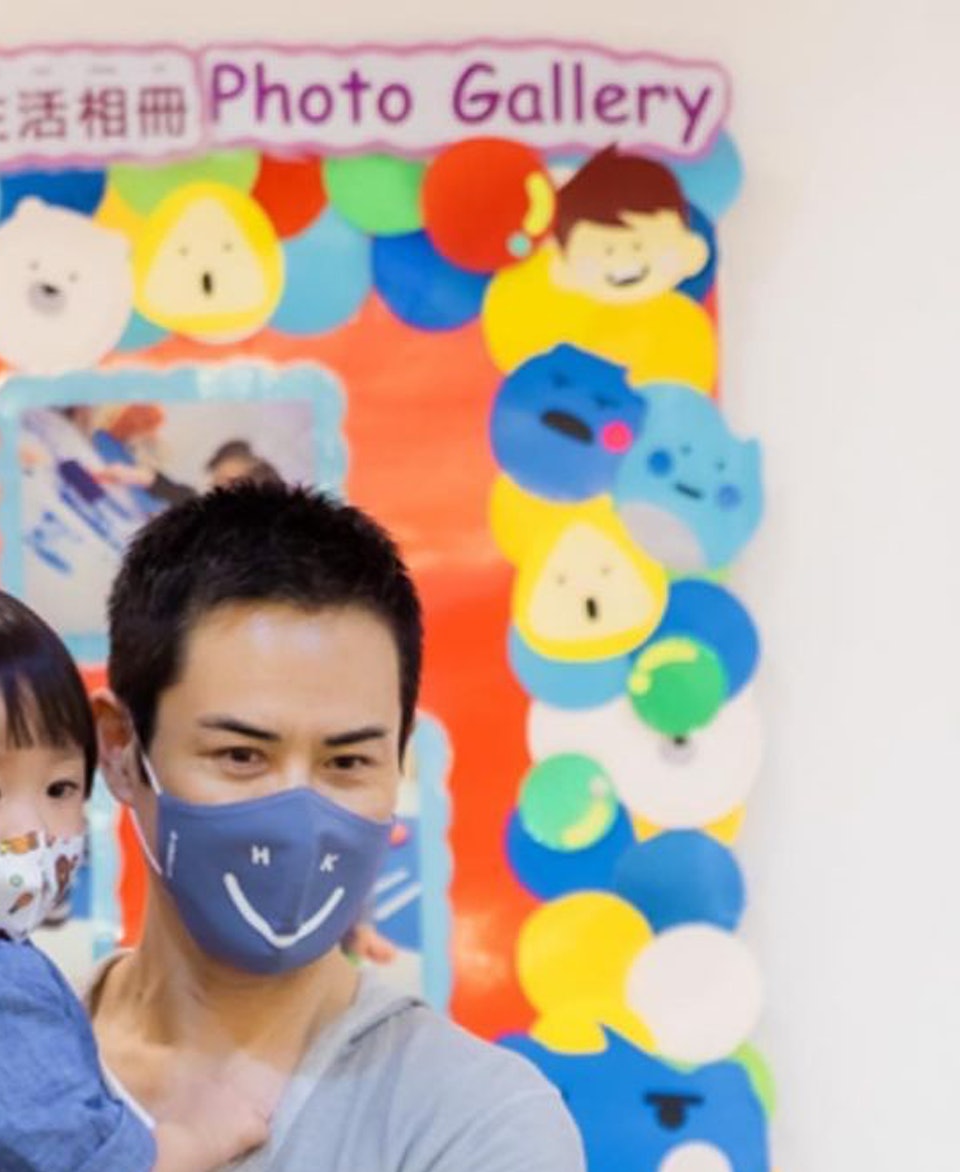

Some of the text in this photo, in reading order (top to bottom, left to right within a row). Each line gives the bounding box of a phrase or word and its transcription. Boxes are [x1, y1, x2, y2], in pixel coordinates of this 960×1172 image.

[211, 60, 712, 144] Photo Gallery
[250, 844, 271, 866] H
